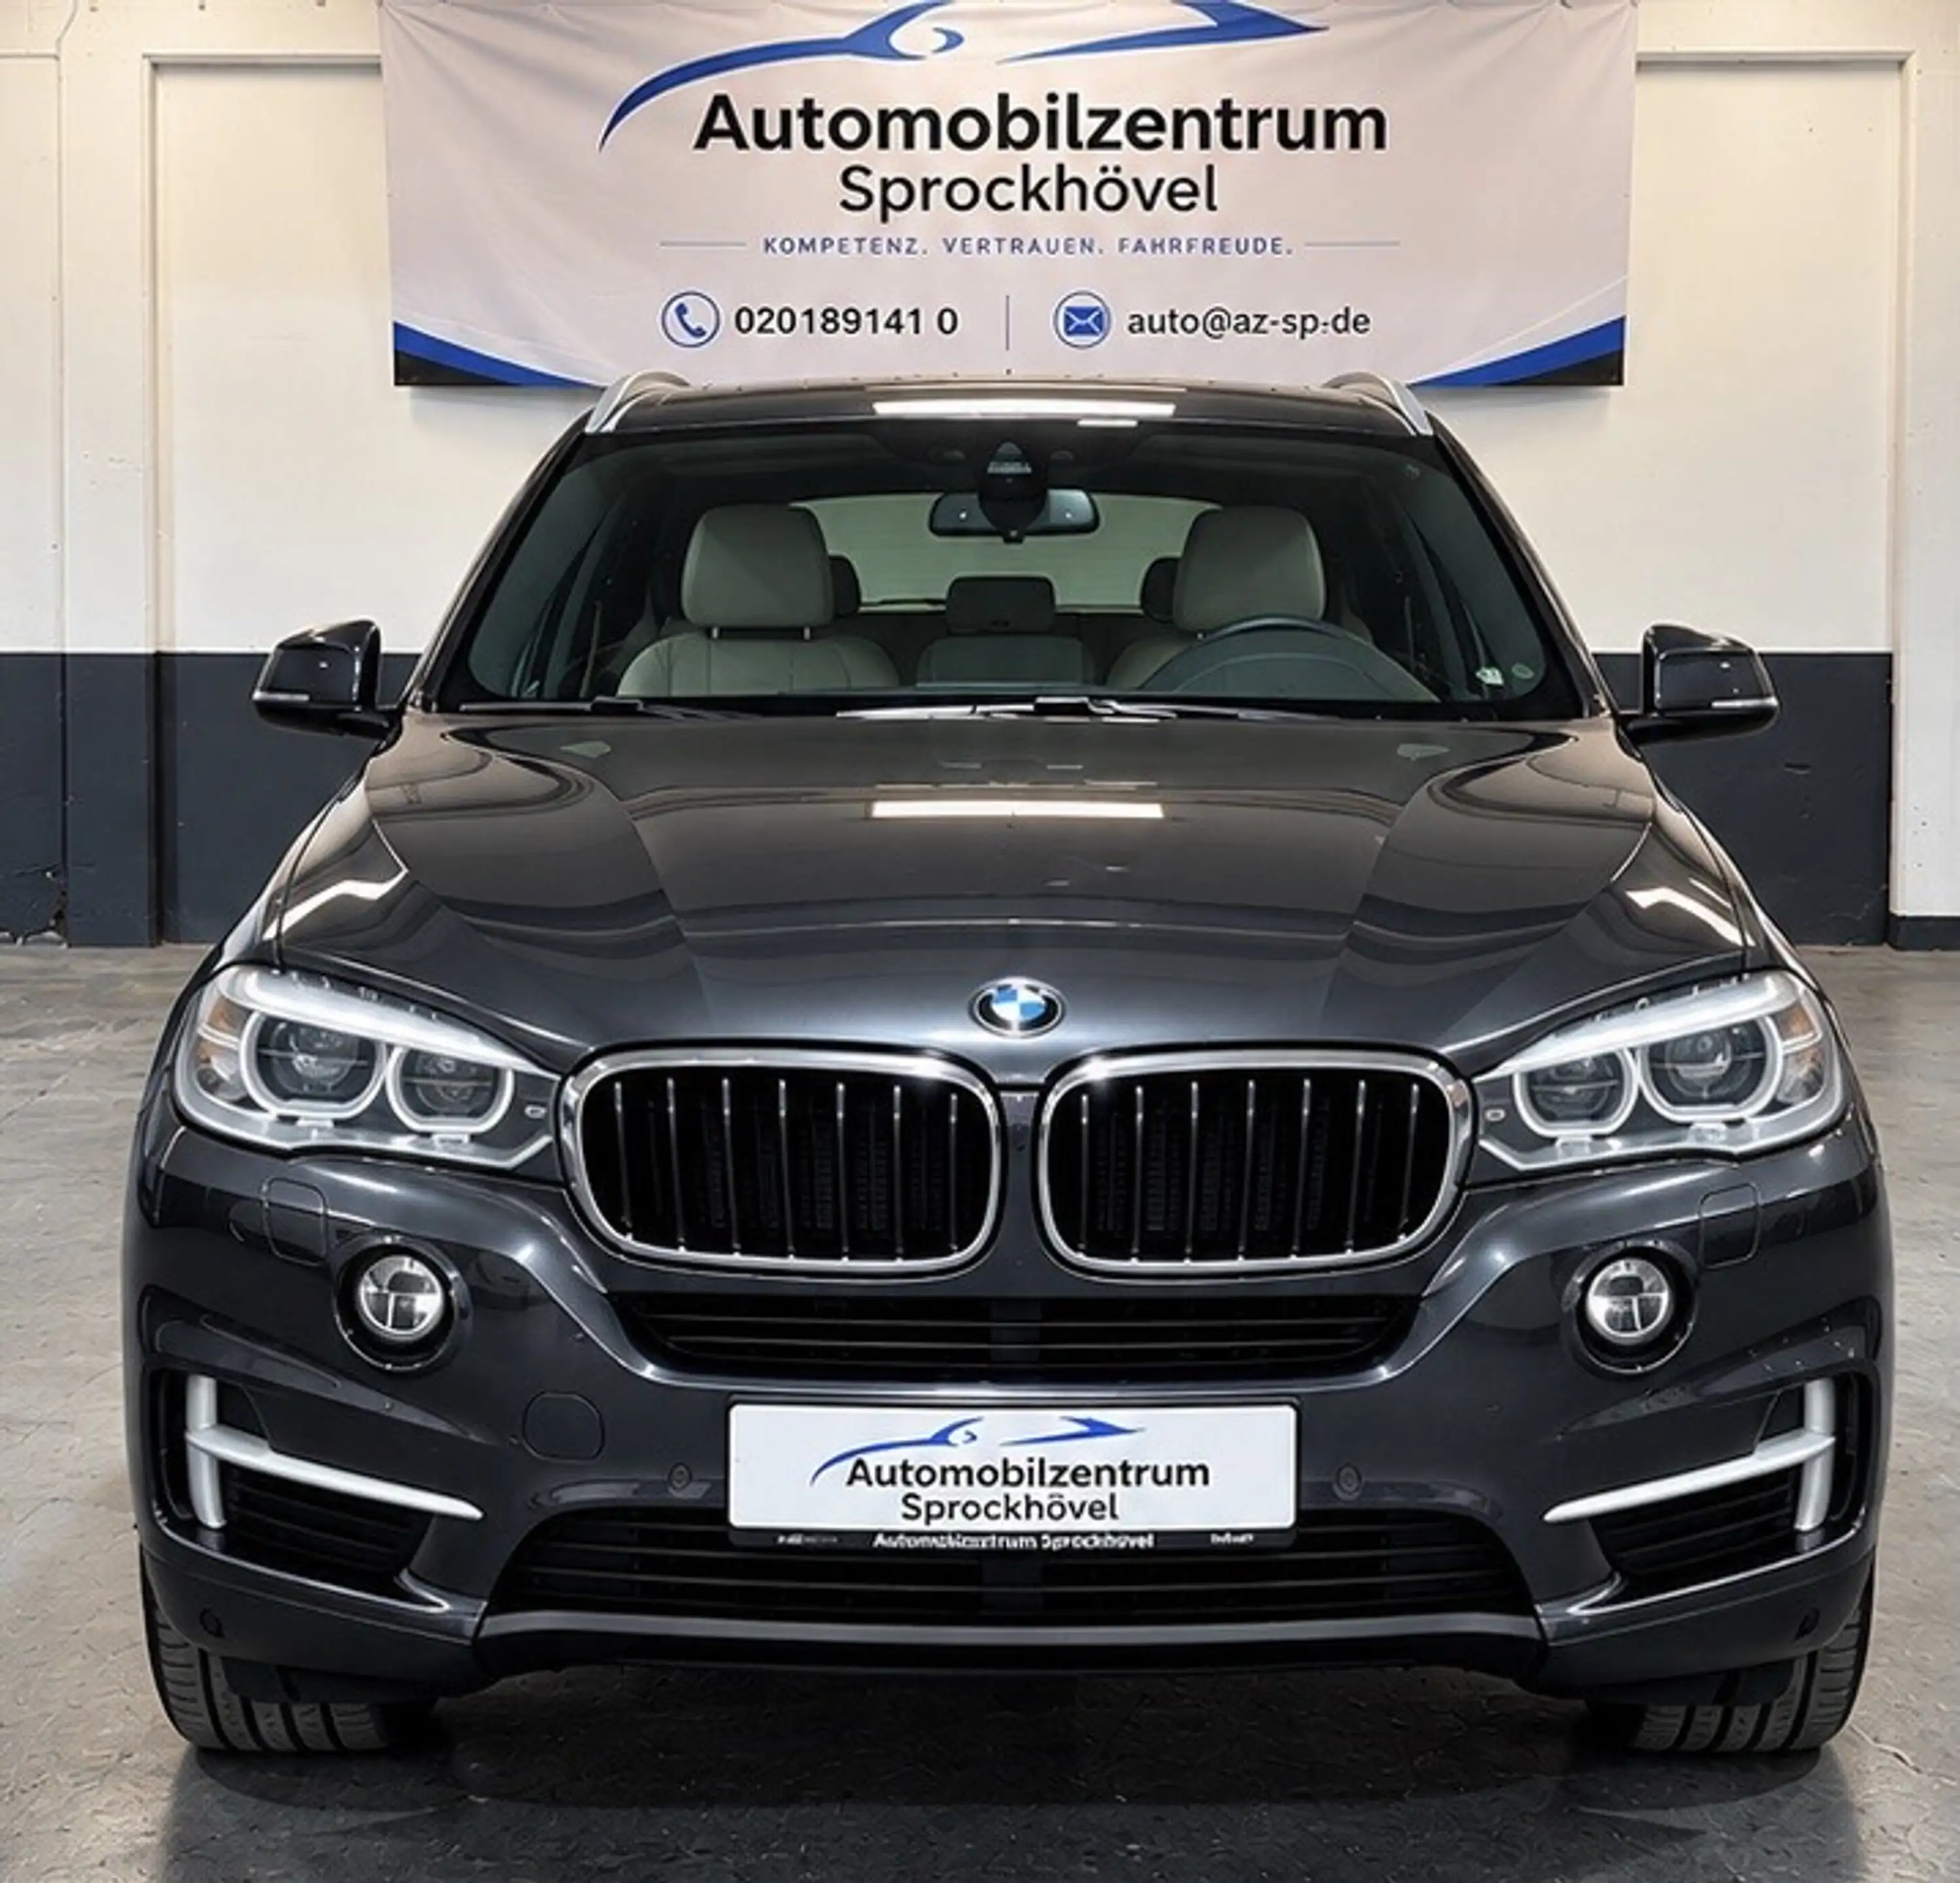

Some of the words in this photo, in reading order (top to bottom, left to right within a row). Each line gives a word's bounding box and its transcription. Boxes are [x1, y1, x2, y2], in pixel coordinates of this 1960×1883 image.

[693, 93, 1386, 151] Automobilzentrum
[838, 163, 1218, 224] Sprockhövel
[763, 237, 928, 255] KOMPETENZ.
[942, 237, 1104, 255] VERTRAUEN.
[1118, 237, 1293, 255] FAHRFREUDE.
[735, 307, 921, 335] 020189141
[846, 1457, 1210, 1487] Automobilzentrum
[901, 1492, 1118, 1526] Sprockhövel
